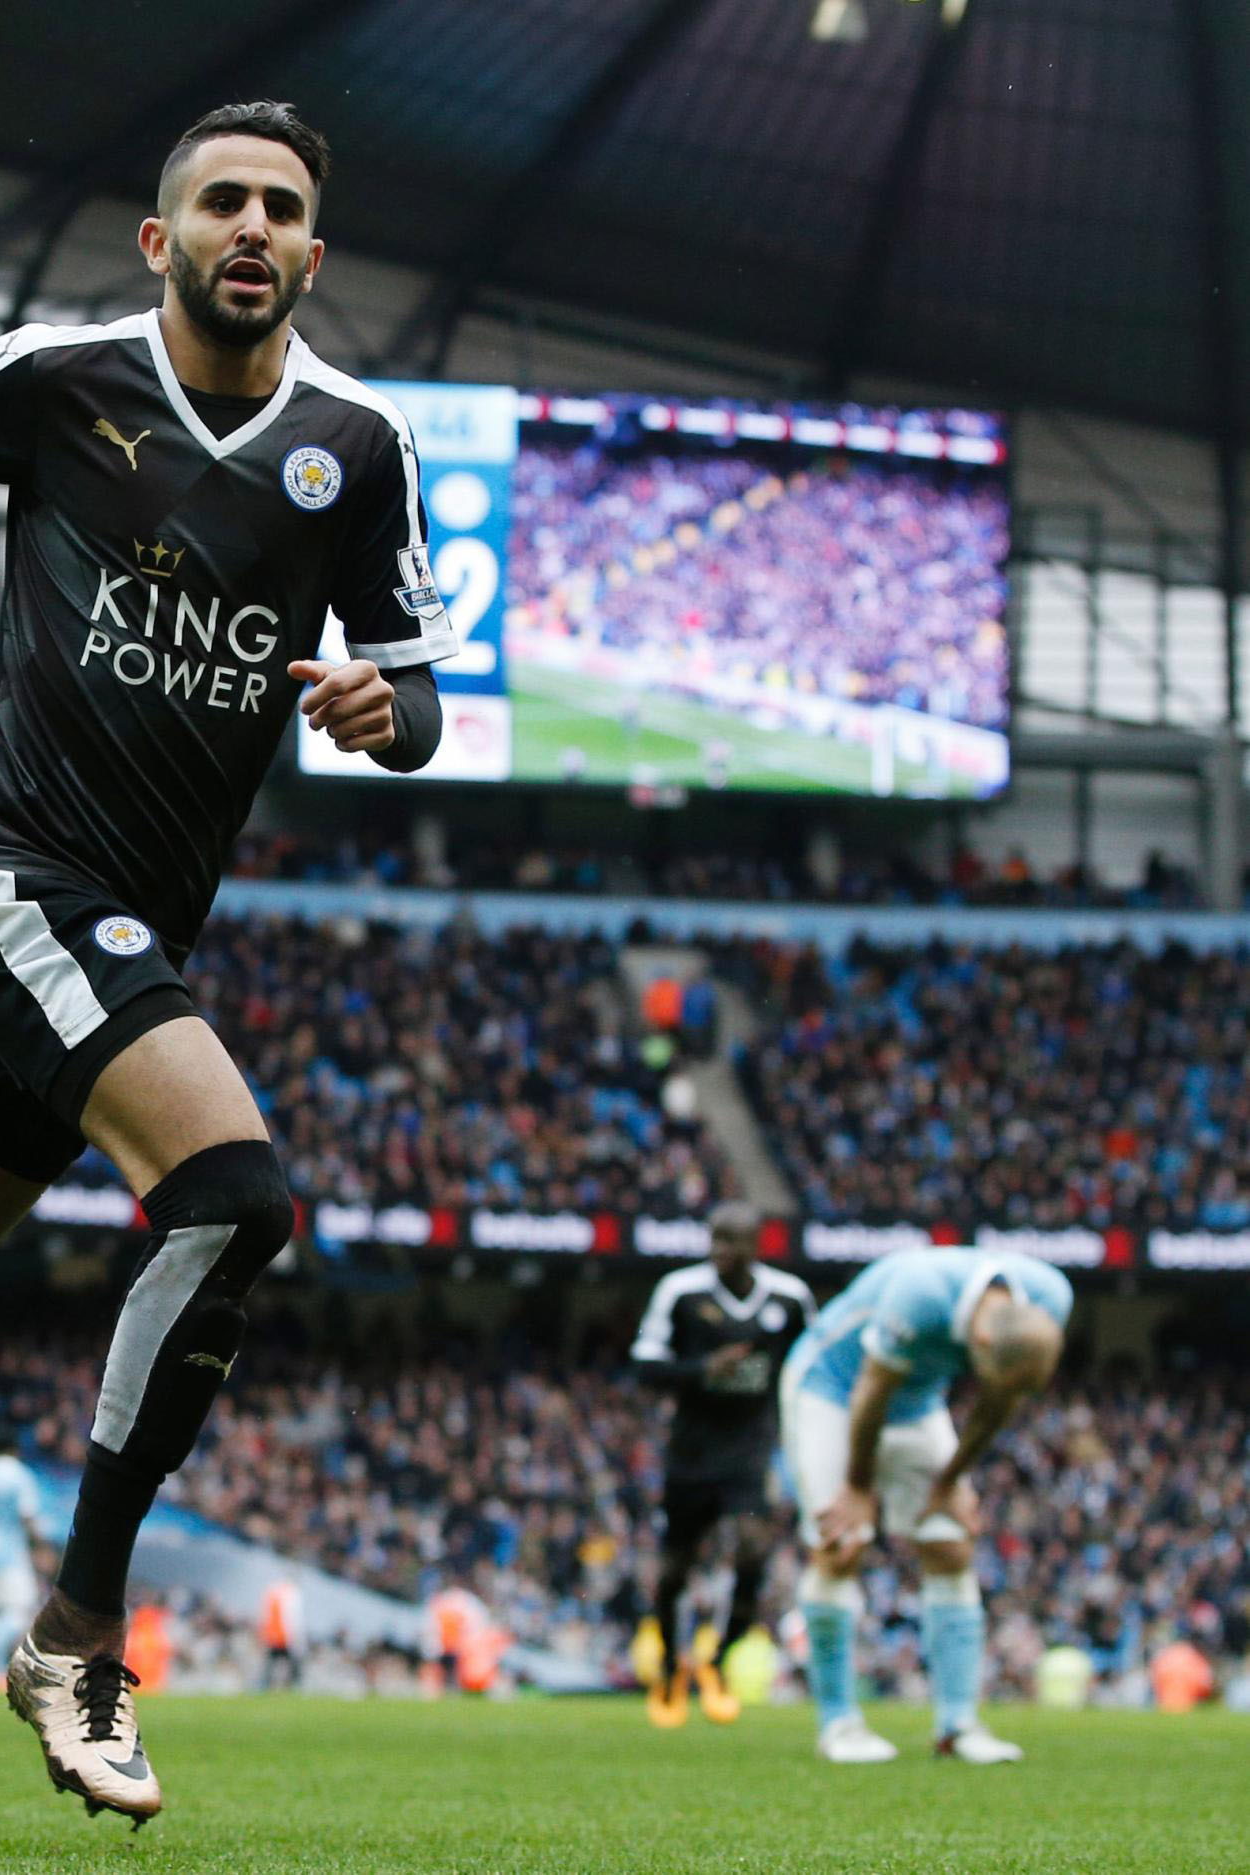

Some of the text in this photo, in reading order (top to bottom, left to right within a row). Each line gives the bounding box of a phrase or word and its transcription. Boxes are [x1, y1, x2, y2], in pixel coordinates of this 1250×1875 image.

[287, 450, 340, 481] LEICESTER CITY
[287, 475, 338, 507] FOOTBALL CLUB
[91, 568, 279, 663] KING
[410, 588, 437, 601] BARCLA
[432, 536, 499, 676] 2
[79, 628, 268, 713] POWER
